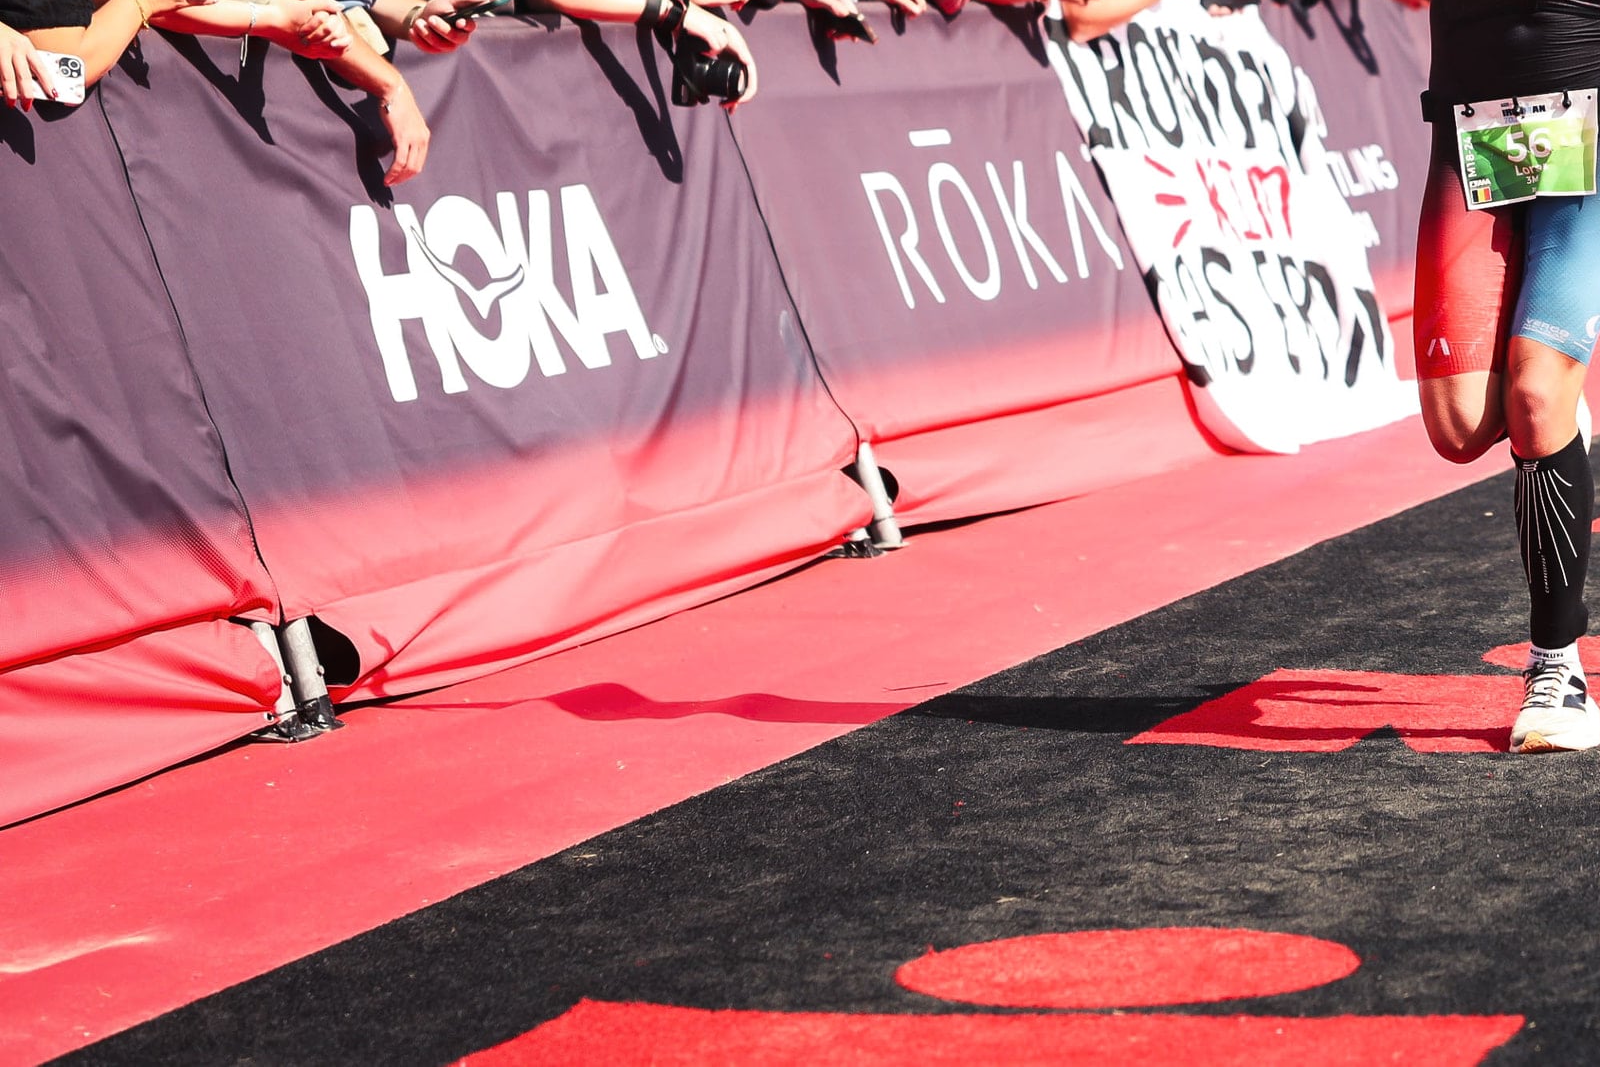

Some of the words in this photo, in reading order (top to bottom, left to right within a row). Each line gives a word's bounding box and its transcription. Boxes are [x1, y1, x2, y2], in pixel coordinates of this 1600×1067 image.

[1463, 136, 1478, 178] M18-24
[1506, 127, 1552, 163] 56
[348, 184, 658, 403] HOKA
